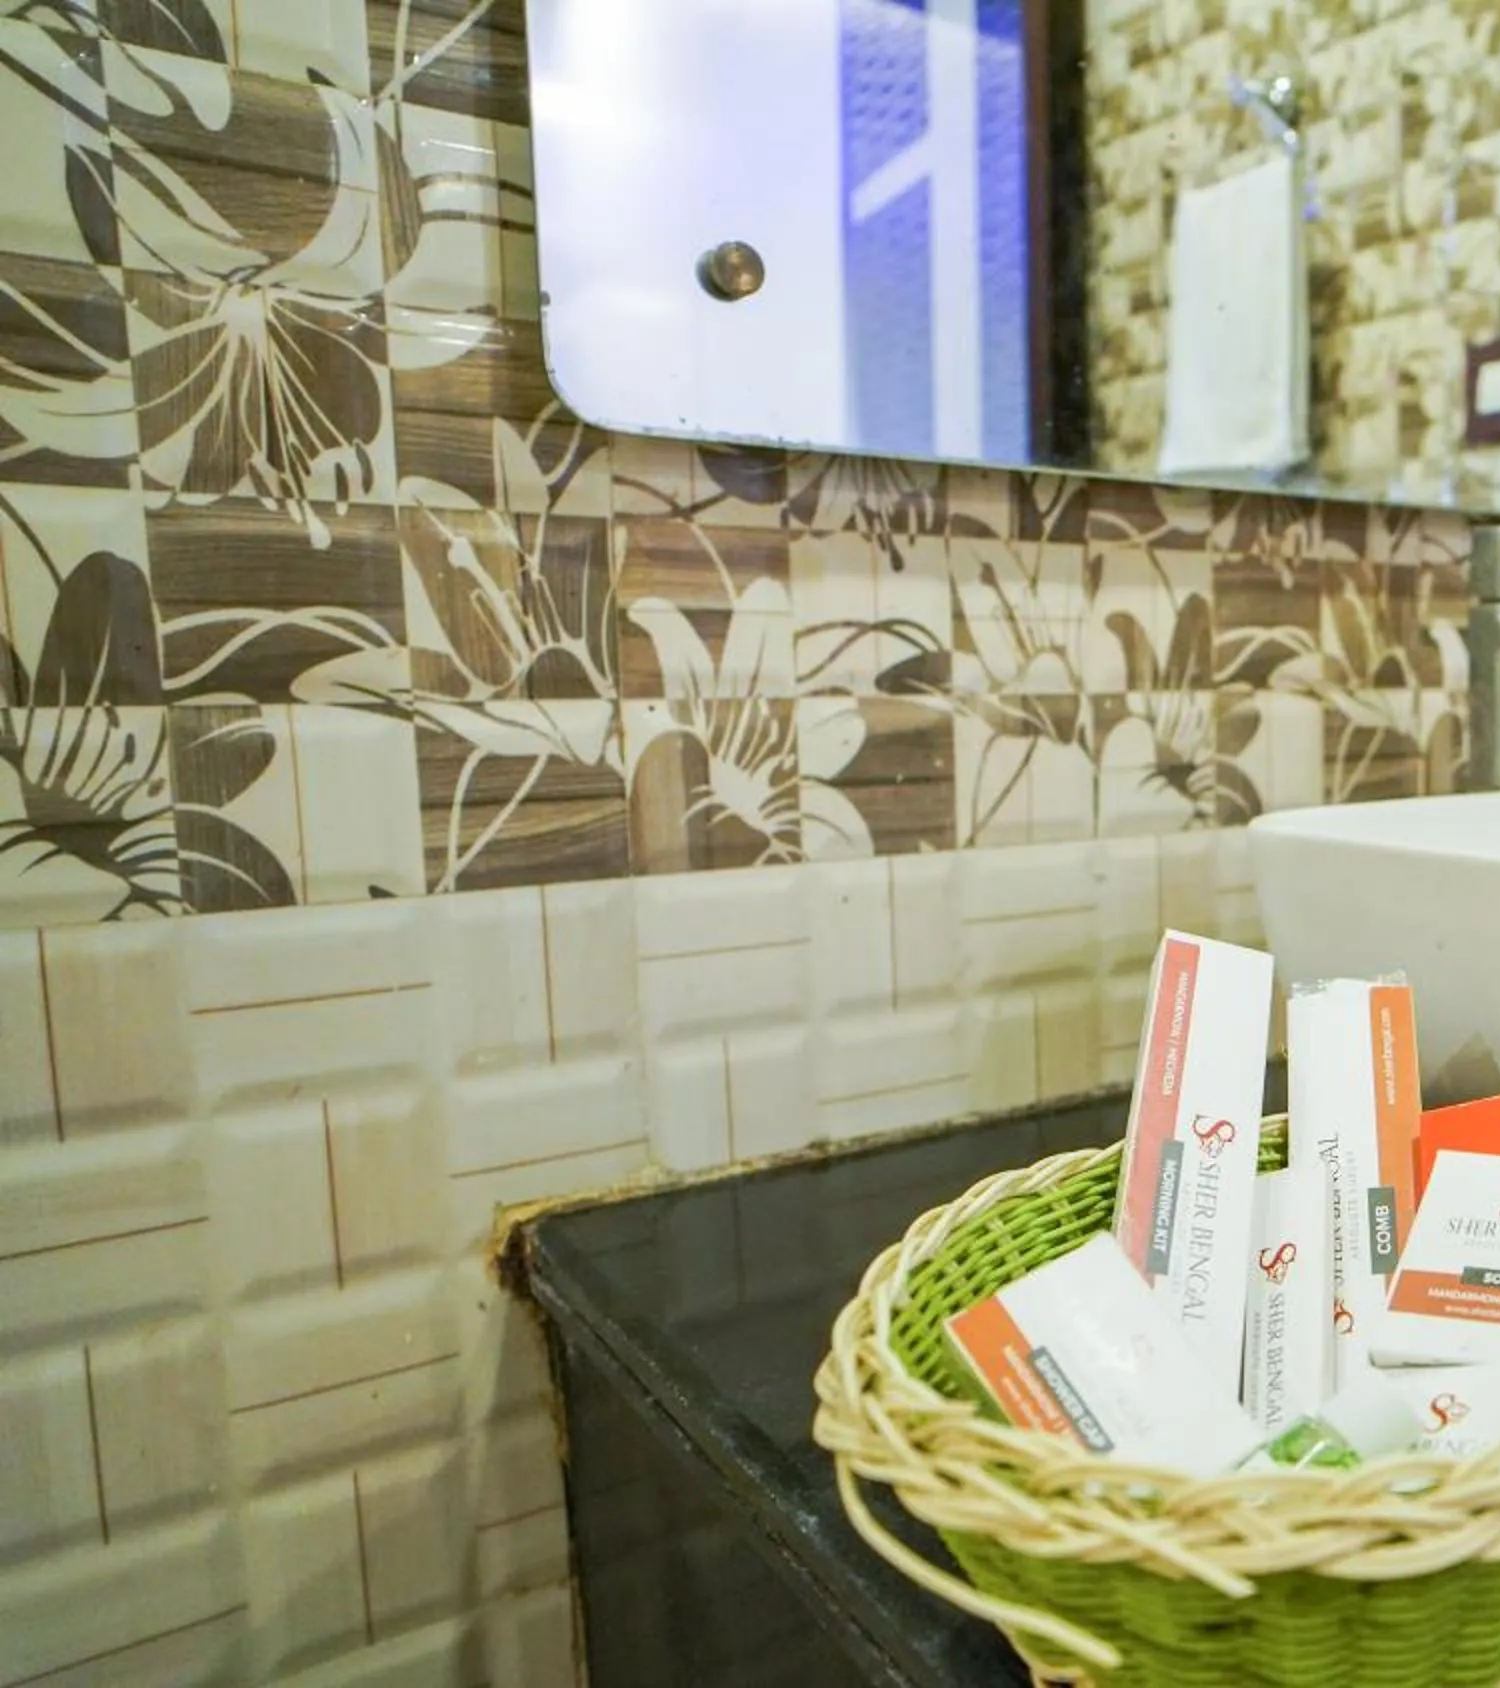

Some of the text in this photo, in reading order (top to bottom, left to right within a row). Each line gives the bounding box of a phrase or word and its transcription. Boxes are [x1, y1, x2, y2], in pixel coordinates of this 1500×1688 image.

[1152, 1159, 1178, 1256] MORNING KIT
[1194, 1161, 1221, 1219] SHER
[1447, 1217, 1498, 1239] SHER
[1375, 1204, 1392, 1256] COMB
[1182, 1226, 1214, 1321] BENGAL
[1264, 1292, 1285, 1429] SHER BENGAL
